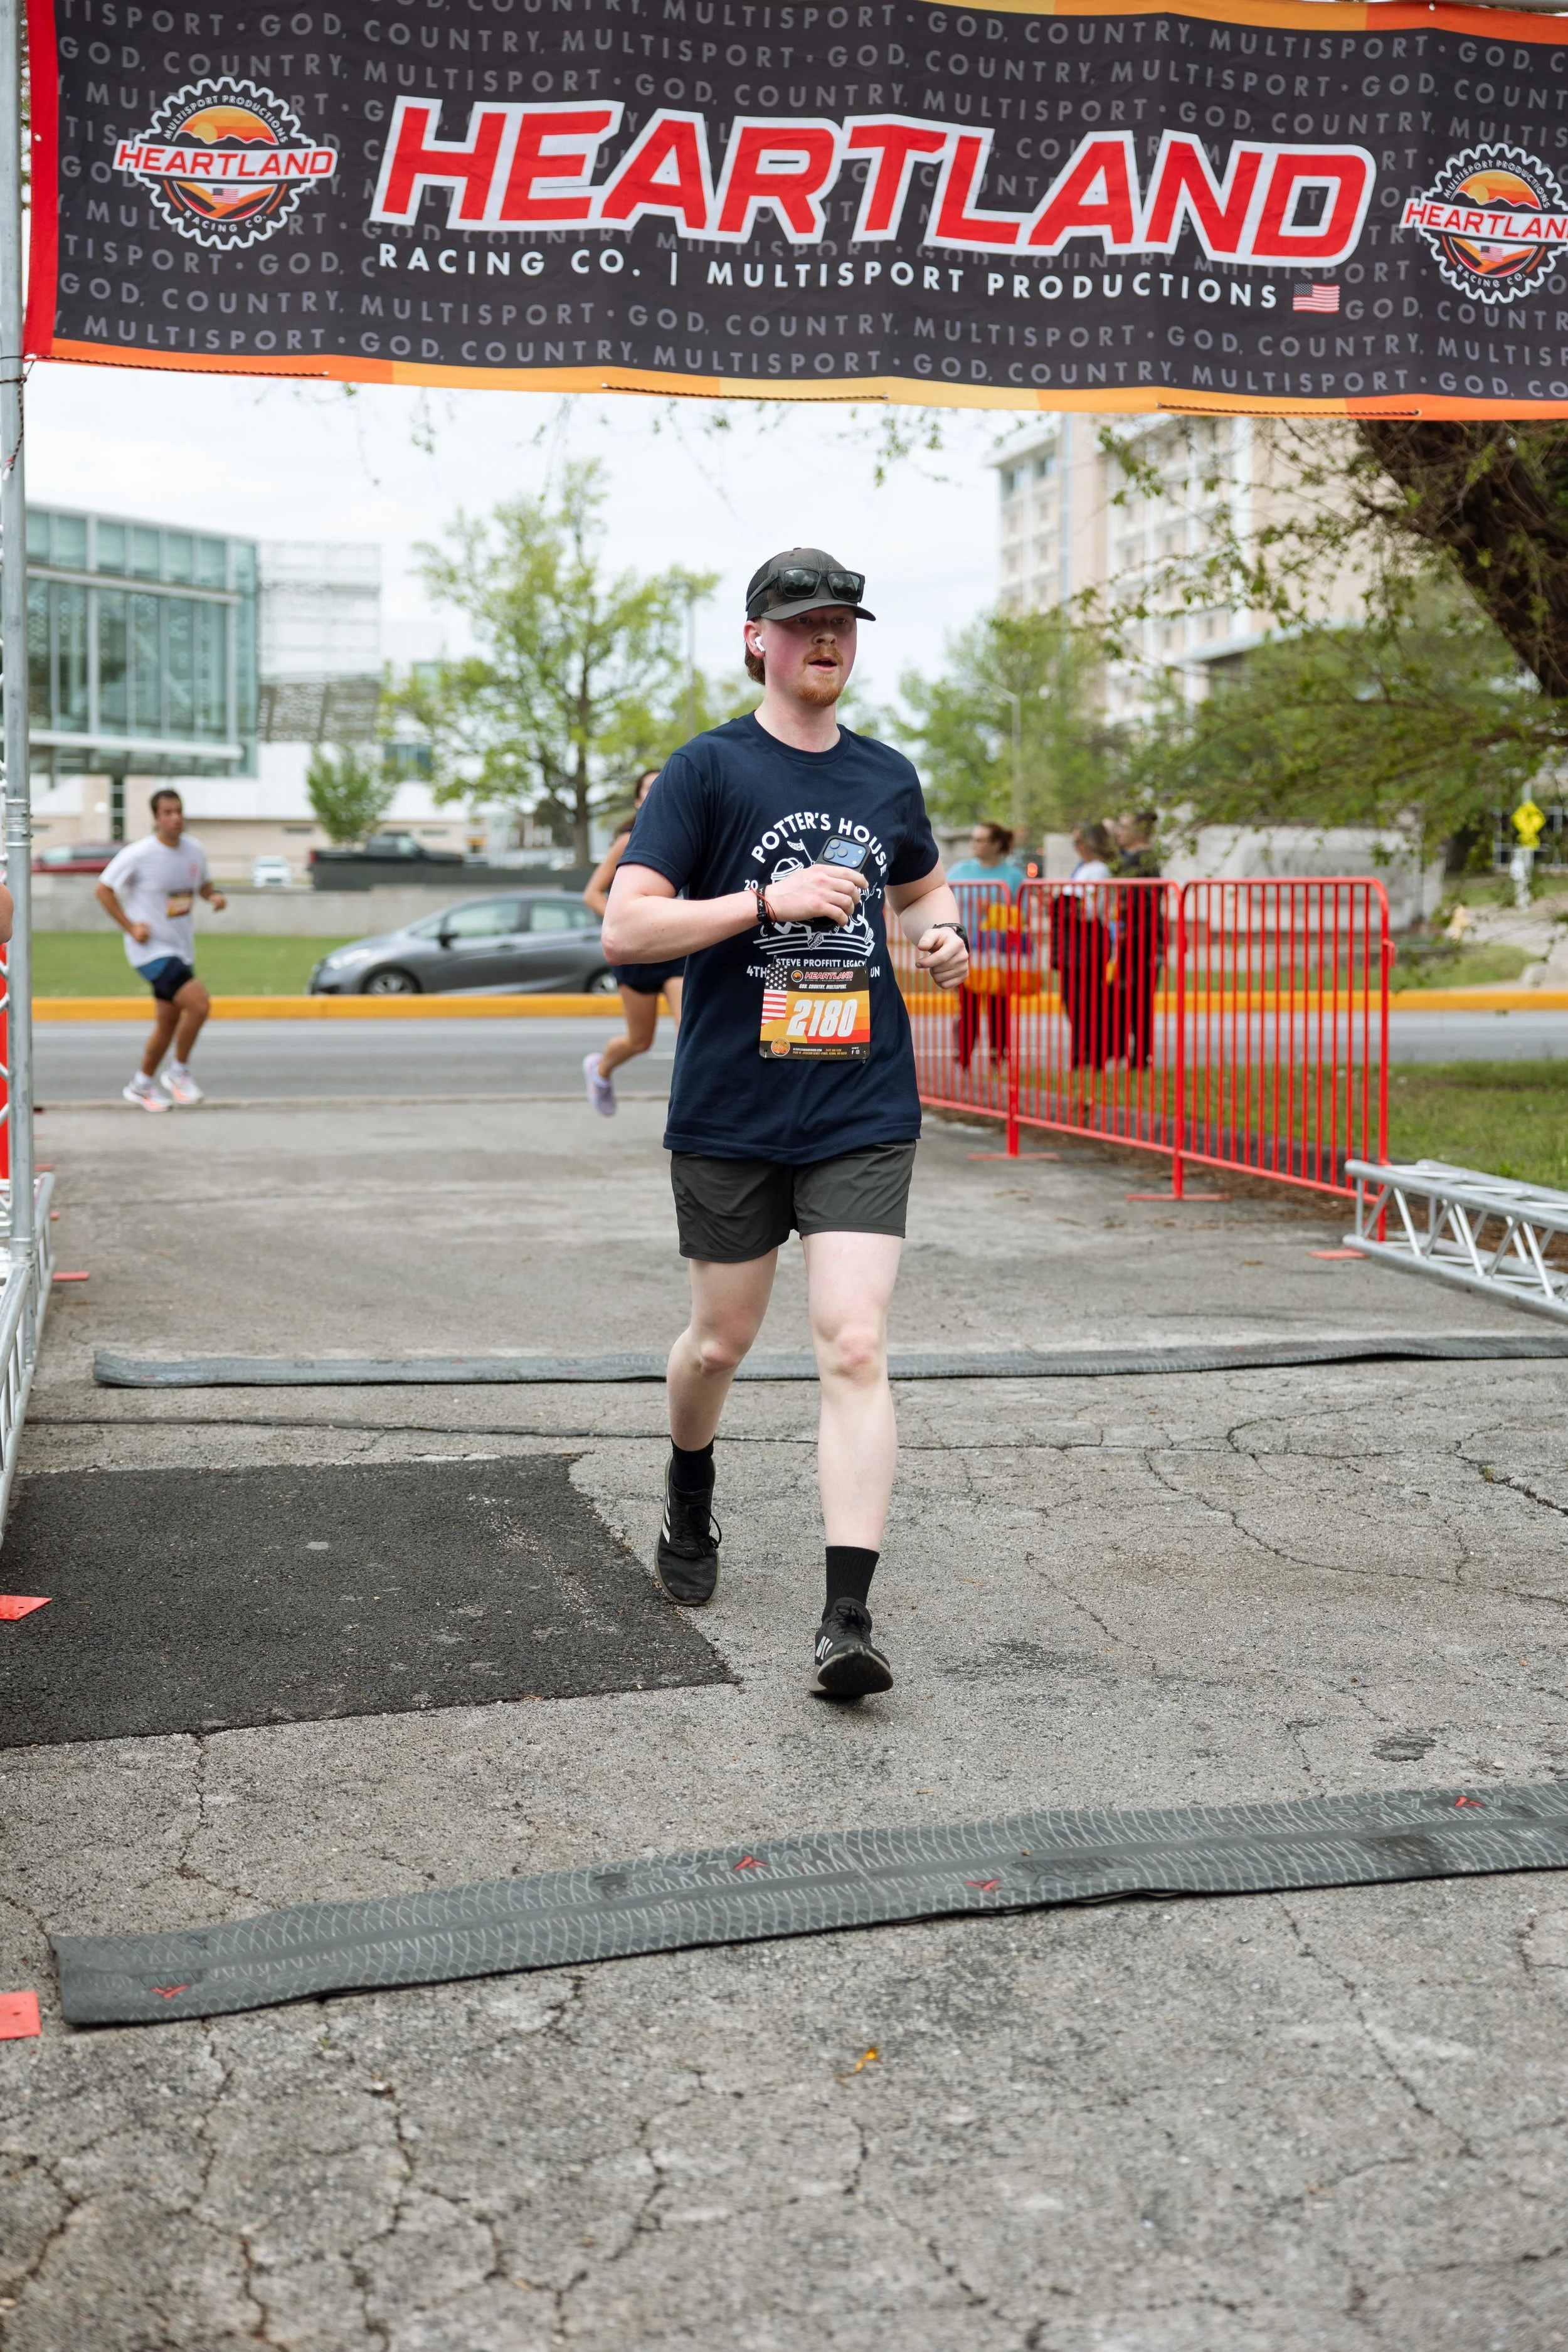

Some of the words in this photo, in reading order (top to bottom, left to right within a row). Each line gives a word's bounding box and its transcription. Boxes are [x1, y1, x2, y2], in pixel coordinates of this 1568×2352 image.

[259, 13, 347, 39] GOD,
[363, 19, 545, 55] COUNTRY,
[561, 28, 794, 68] MULTISPORT
[827, 43, 910, 68] GOD,
[925, 50, 1095, 85] COUNTRY,
[1110, 59, 1331, 97] MULTISPORT
[1361, 72, 1439, 97] GOD,
[662, 0, 896, 29] MULTISPORT
[928, 11, 1009, 43] GOD,
[1024, 19, 1194, 47] COUNTRY,
[1209, 28, 1429, 60] MULTISPORT
[1458, 41, 1534, 73] GOD,
[59, 36, 146, 72] GOD,
[163, 51, 347, 79] COUNTRY,
[363, 60, 601, 93] MULTISPORT
[635, 73, 718, 105] GOD,
[734, 82, 908, 108] COUNTRY,
[923, 88, 1148, 122] MULTISPORT
[1179, 101, 1255, 134] GOD,
[1271, 110, 1436, 135] COUNTRY,
[163, 95, 219, 140] MULTISPORT
[221, 94, 289, 144] PRODUCTIONS
[117, 143, 334, 177] HEARTLAND
[369, 96, 1377, 268] HEARTLAND
[1443, 159, 1493, 201] MULTISPORT
[1495, 159, 1551, 209] PRODUCTIONS
[183, 209, 238, 233] RACING
[1404, 201, 1568, 240] HEARTLAN
[258, 251, 344, 276] GOD,
[379, 243, 545, 276] RACING
[571, 248, 640, 277] CO.
[706, 260, 964, 292] MULTISPORT
[987, 272, 1277, 309] PRODUCTIONS
[1456, 263, 1500, 287] RACING
[59, 272, 145, 307] GOD,
[161, 288, 344, 314] COUNTRY,
[360, 294, 595, 326] MULTISPORT
[628, 304, 709, 335] GOD,
[725, 312, 899, 337] COUNTRY,
[913, 316, 1135, 348] MULTISPORT
[1167, 325, 1243, 356] GOD,
[1258, 332, 1424, 358] COUNTRY,
[1345, 295, 1424, 320] GOD,
[83, 314, 326, 351] MULTISPORT
[359, 331, 445, 361] GOD,
[460, 339, 638, 364] COUNTRY,
[653, 345, 881, 374] MULTISPORT
[913, 353, 993, 382] GOD,
[1008, 360, 1177, 384] COUNTRY,
[1192, 364, 1409, 393] MULTISPORT
[1438, 371, 1515, 398] GOD,
[751, 812, 832, 864] POTTER'S
[837, 817, 887, 877] HOUSE
[746, 965, 767, 978] 4TH
[775, 958, 801, 967] STEVE
[803, 959, 841, 967] PROFFITT
[843, 960, 866, 968] LEGACY
[786, 999, 858, 1037] 2180
